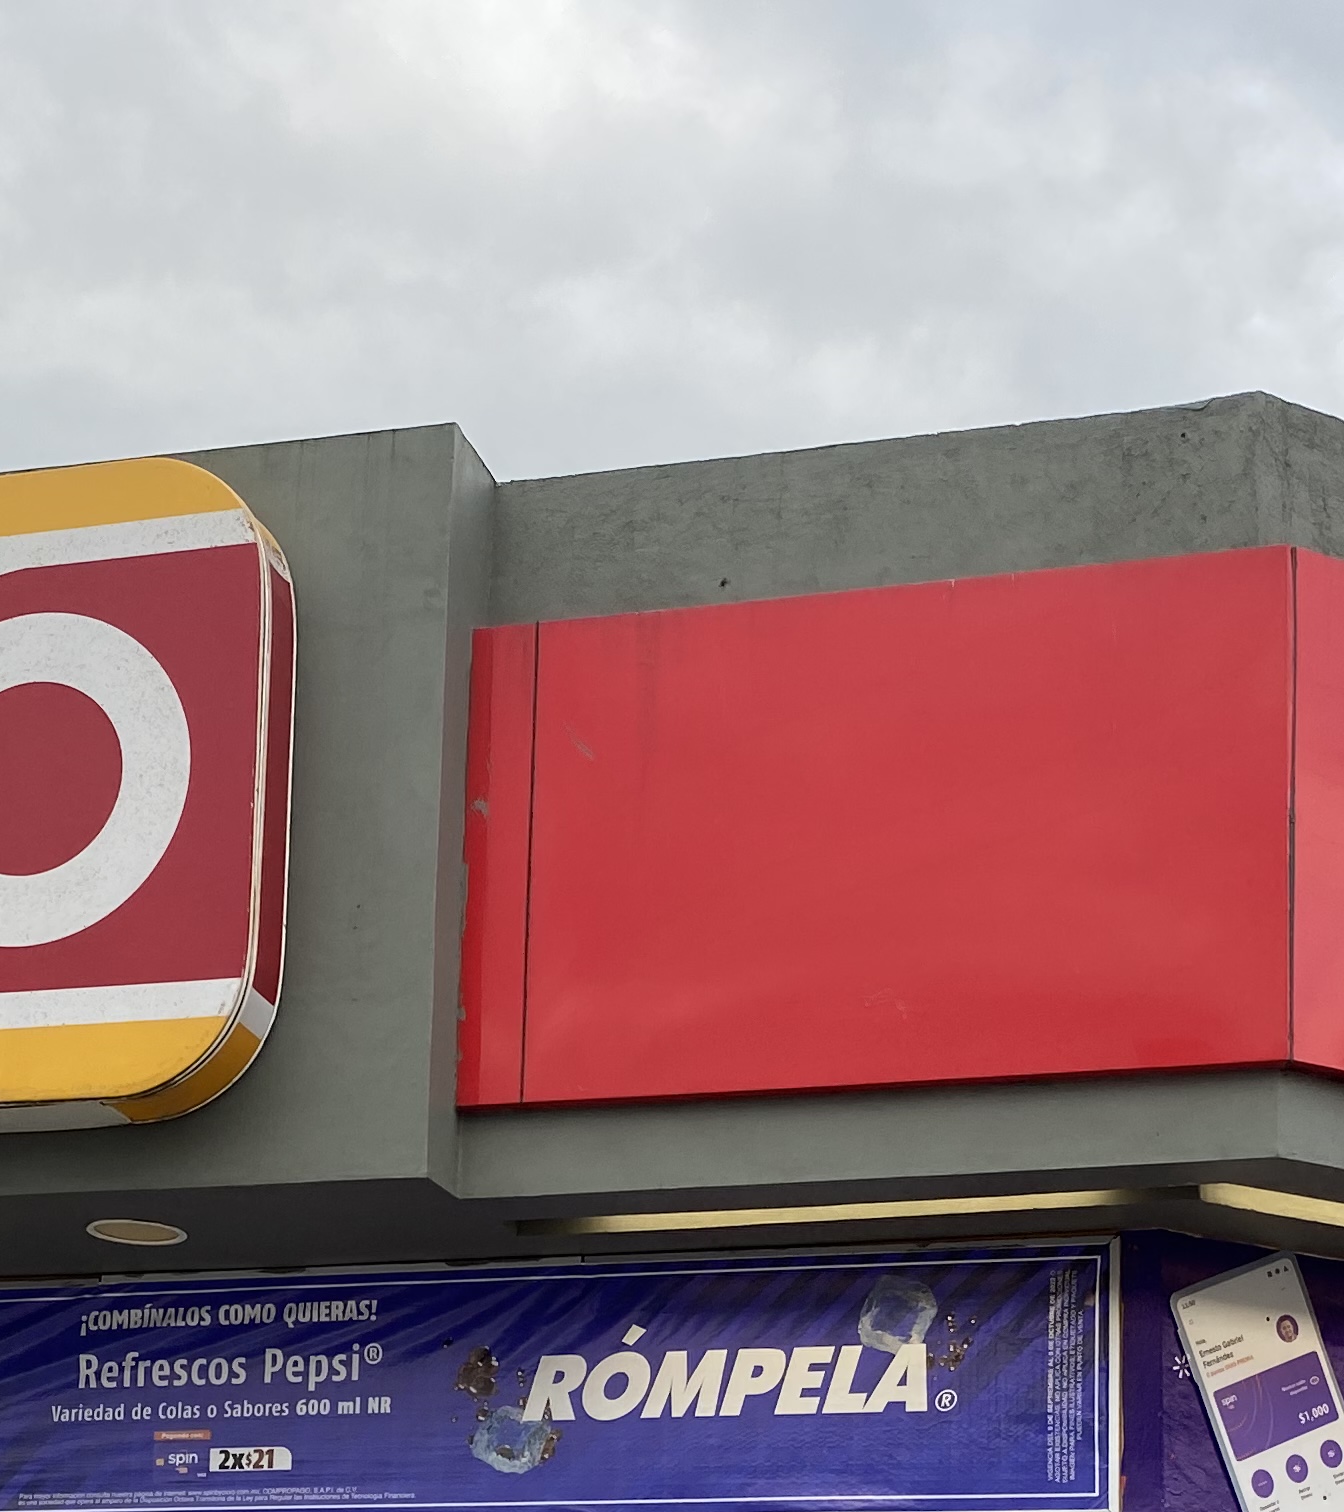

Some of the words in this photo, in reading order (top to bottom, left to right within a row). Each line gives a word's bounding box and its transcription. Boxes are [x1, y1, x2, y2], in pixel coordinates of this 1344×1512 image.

[80, 1304, 212, 1336] ¡COMBÍNALOS
[218, 1303, 277, 1326] COMO
[283, 1300, 379, 1328] QUIERAS!
[78, 1351, 247, 1389] Refrescos
[51, 1403, 125, 1422] Variedad
[131, 1403, 152, 1420] de
[158, 1401, 201, 1420] Colas
[207, 1406, 217, 1418] o
[223, 1400, 289, 1418] Sabores
[295, 1399, 331, 1416] 600
[337, 1397, 361, 1415] ml
[367, 1396, 392, 1414] NR
[1298, 1402, 1330, 1425] $1,000
[167, 1450, 199, 1467] spin
[218, 1448, 275, 1470] 2x$21
